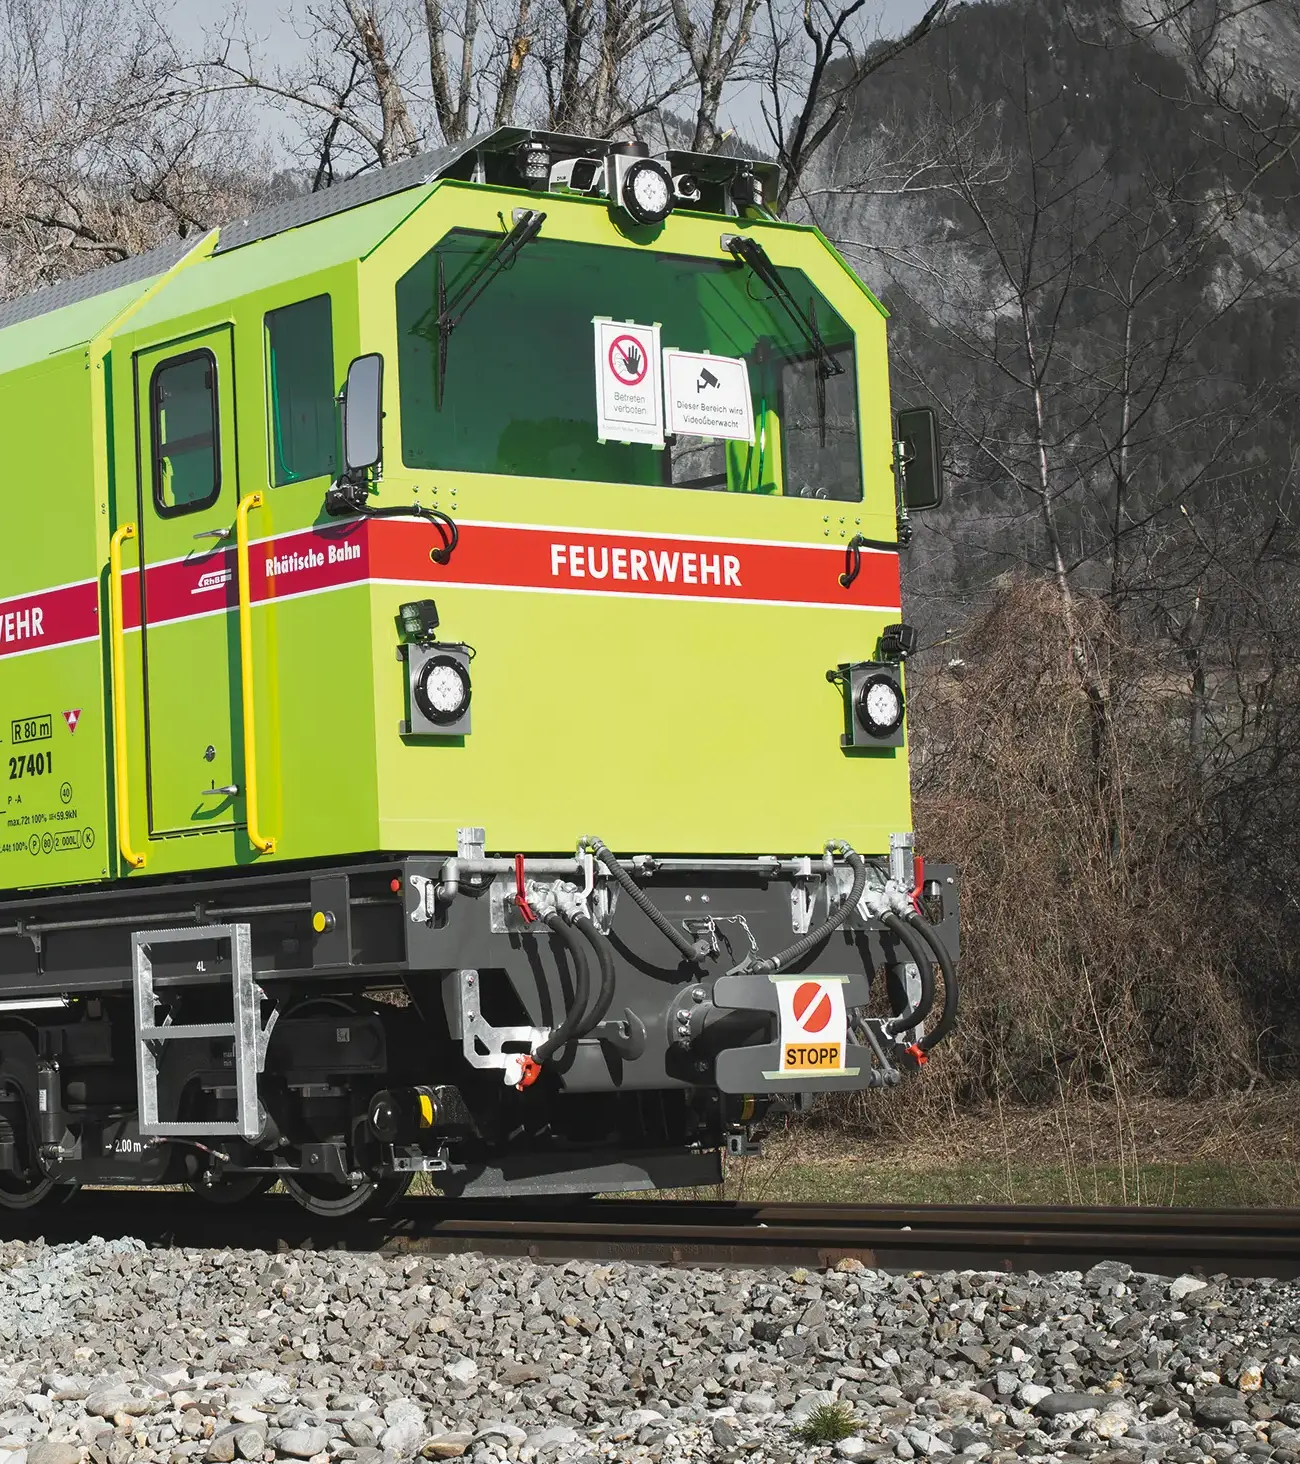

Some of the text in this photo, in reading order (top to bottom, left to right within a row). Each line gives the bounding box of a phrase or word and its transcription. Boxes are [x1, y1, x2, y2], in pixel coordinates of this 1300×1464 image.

[614, 391, 646, 404] Betreten
[613, 404, 647, 415] verboten
[676, 400, 744, 415] Dieser Bereich wird
[265, 541, 361, 577] Rhätische Bahn
[551, 543, 742, 587] FEUERWEHR
[15, 721, 50, 740] R 80 m
[9, 751, 52, 780] 27401
[196, 961, 206, 972] 4L
[786, 1048, 838, 1065] STOPP
[115, 1139, 142, 1152] 2.00 m
